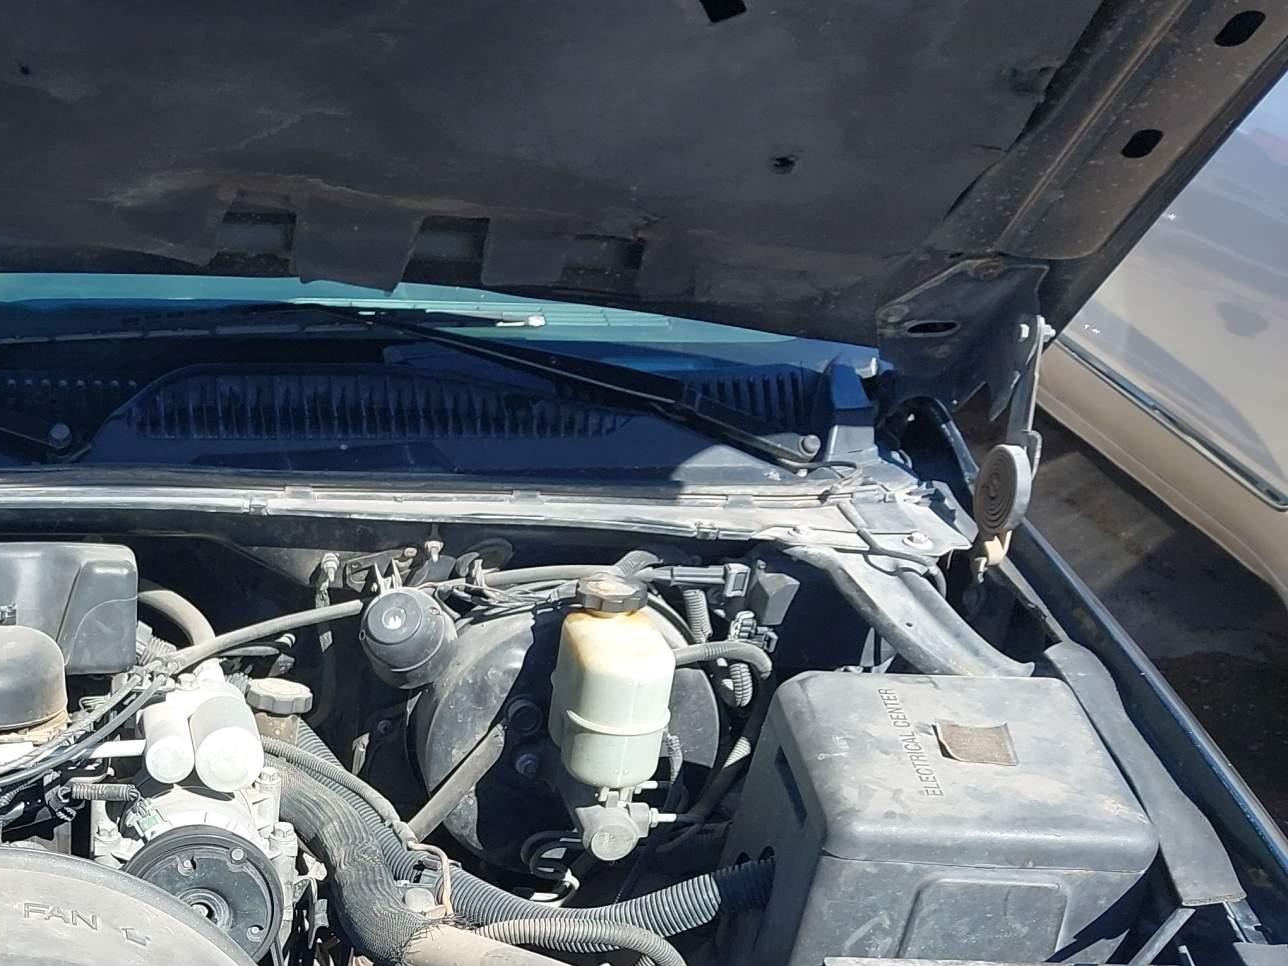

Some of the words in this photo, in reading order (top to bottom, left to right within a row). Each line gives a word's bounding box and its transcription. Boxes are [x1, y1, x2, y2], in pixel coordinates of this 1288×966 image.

[878, 688, 911, 728] CENTER
[900, 731, 944, 797] ELECTRICAL
[24, 901, 99, 932] FAN
